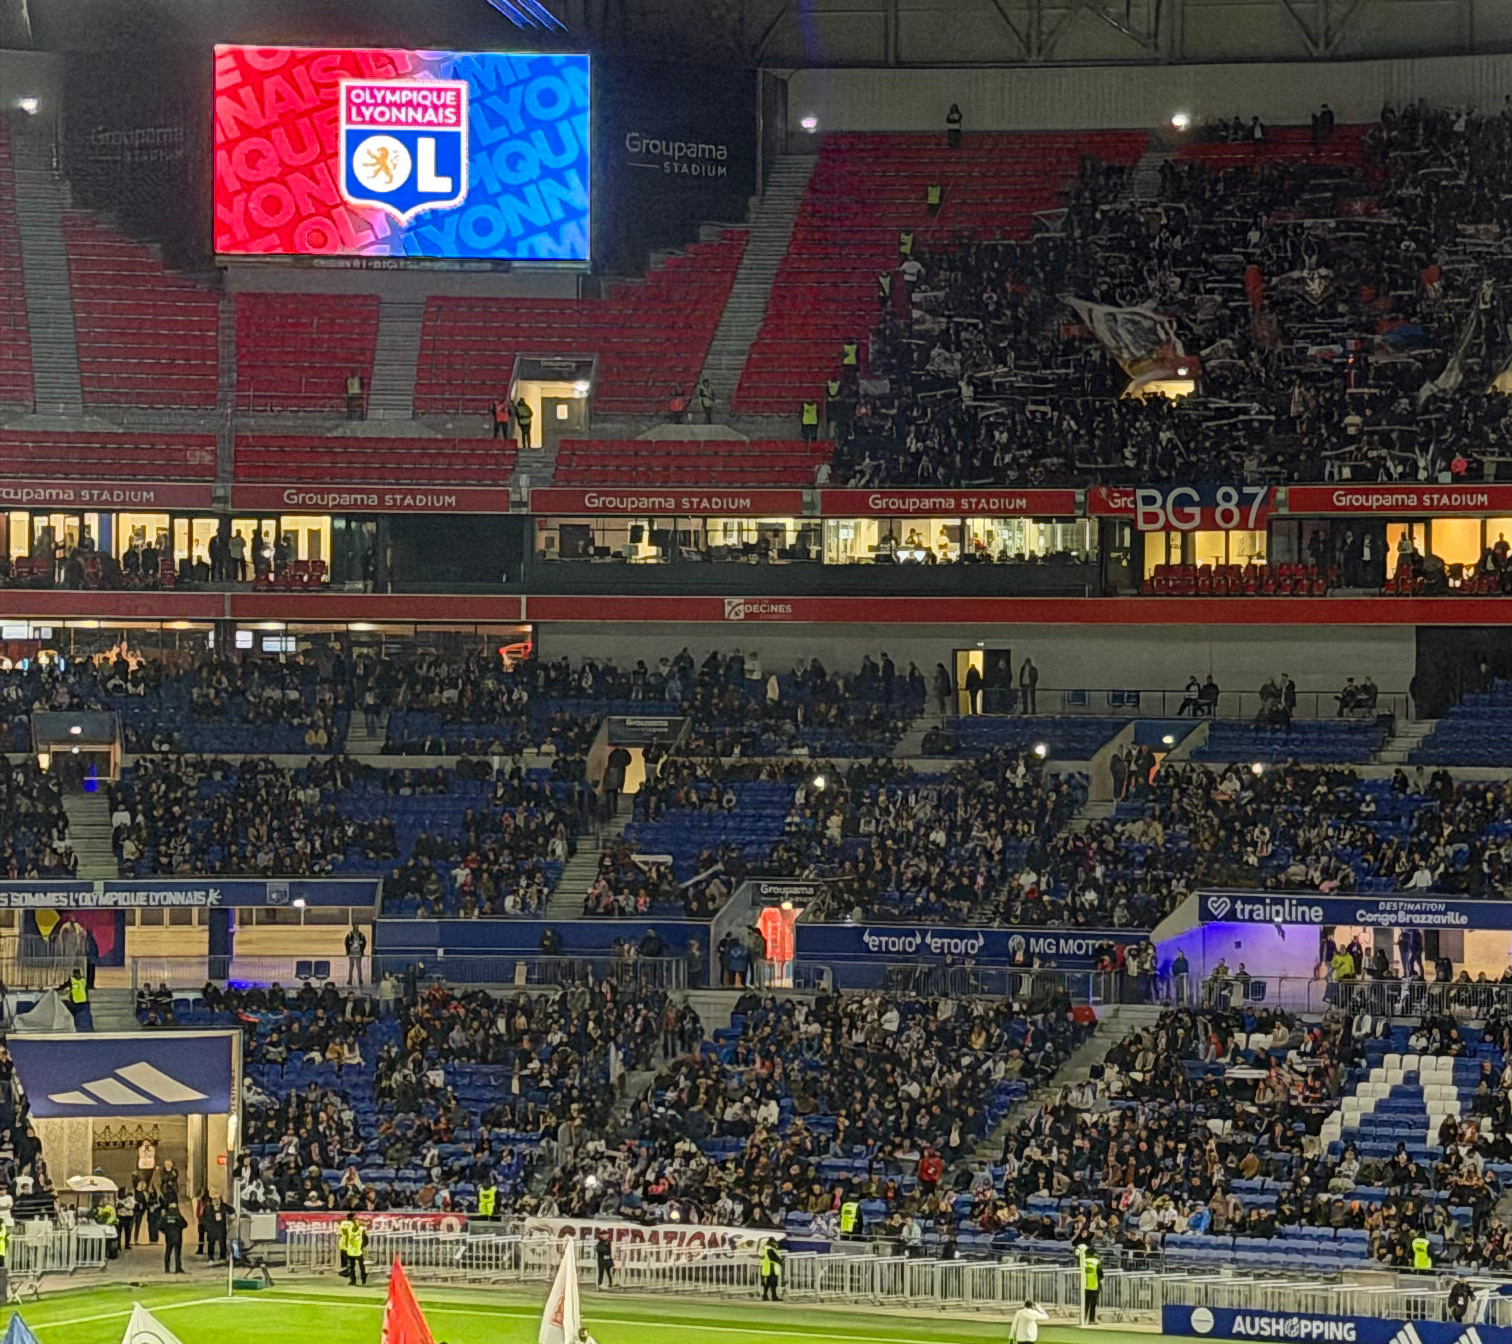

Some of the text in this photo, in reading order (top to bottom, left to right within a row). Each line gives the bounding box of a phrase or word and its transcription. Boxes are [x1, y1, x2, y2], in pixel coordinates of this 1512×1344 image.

[350, 88, 457, 106] OLYMPIQUE
[351, 106, 457, 124] LYONNAIS
[625, 132, 728, 160] Groupama
[352, 135, 453, 193] OL
[663, 161, 728, 177] STADIUM
[0, 488, 155, 503] oupama STADIUM
[283, 489, 457, 508] Groupama STADIUM
[584, 493, 751, 510] Groupama STADIUM
[868, 493, 1027, 511] Groupama STADIUM
[1332, 490, 1489, 509] Groupama STADIUM
[1136, 485, 1268, 531] BG 87
[10, 892, 68, 906] SOMMES
[149, 891, 206, 906] LYONNAIS
[1378, 901, 1446, 912] DESTINATION
[1235, 899, 1324, 923] trainline
[1029, 937, 1057, 954] MG
